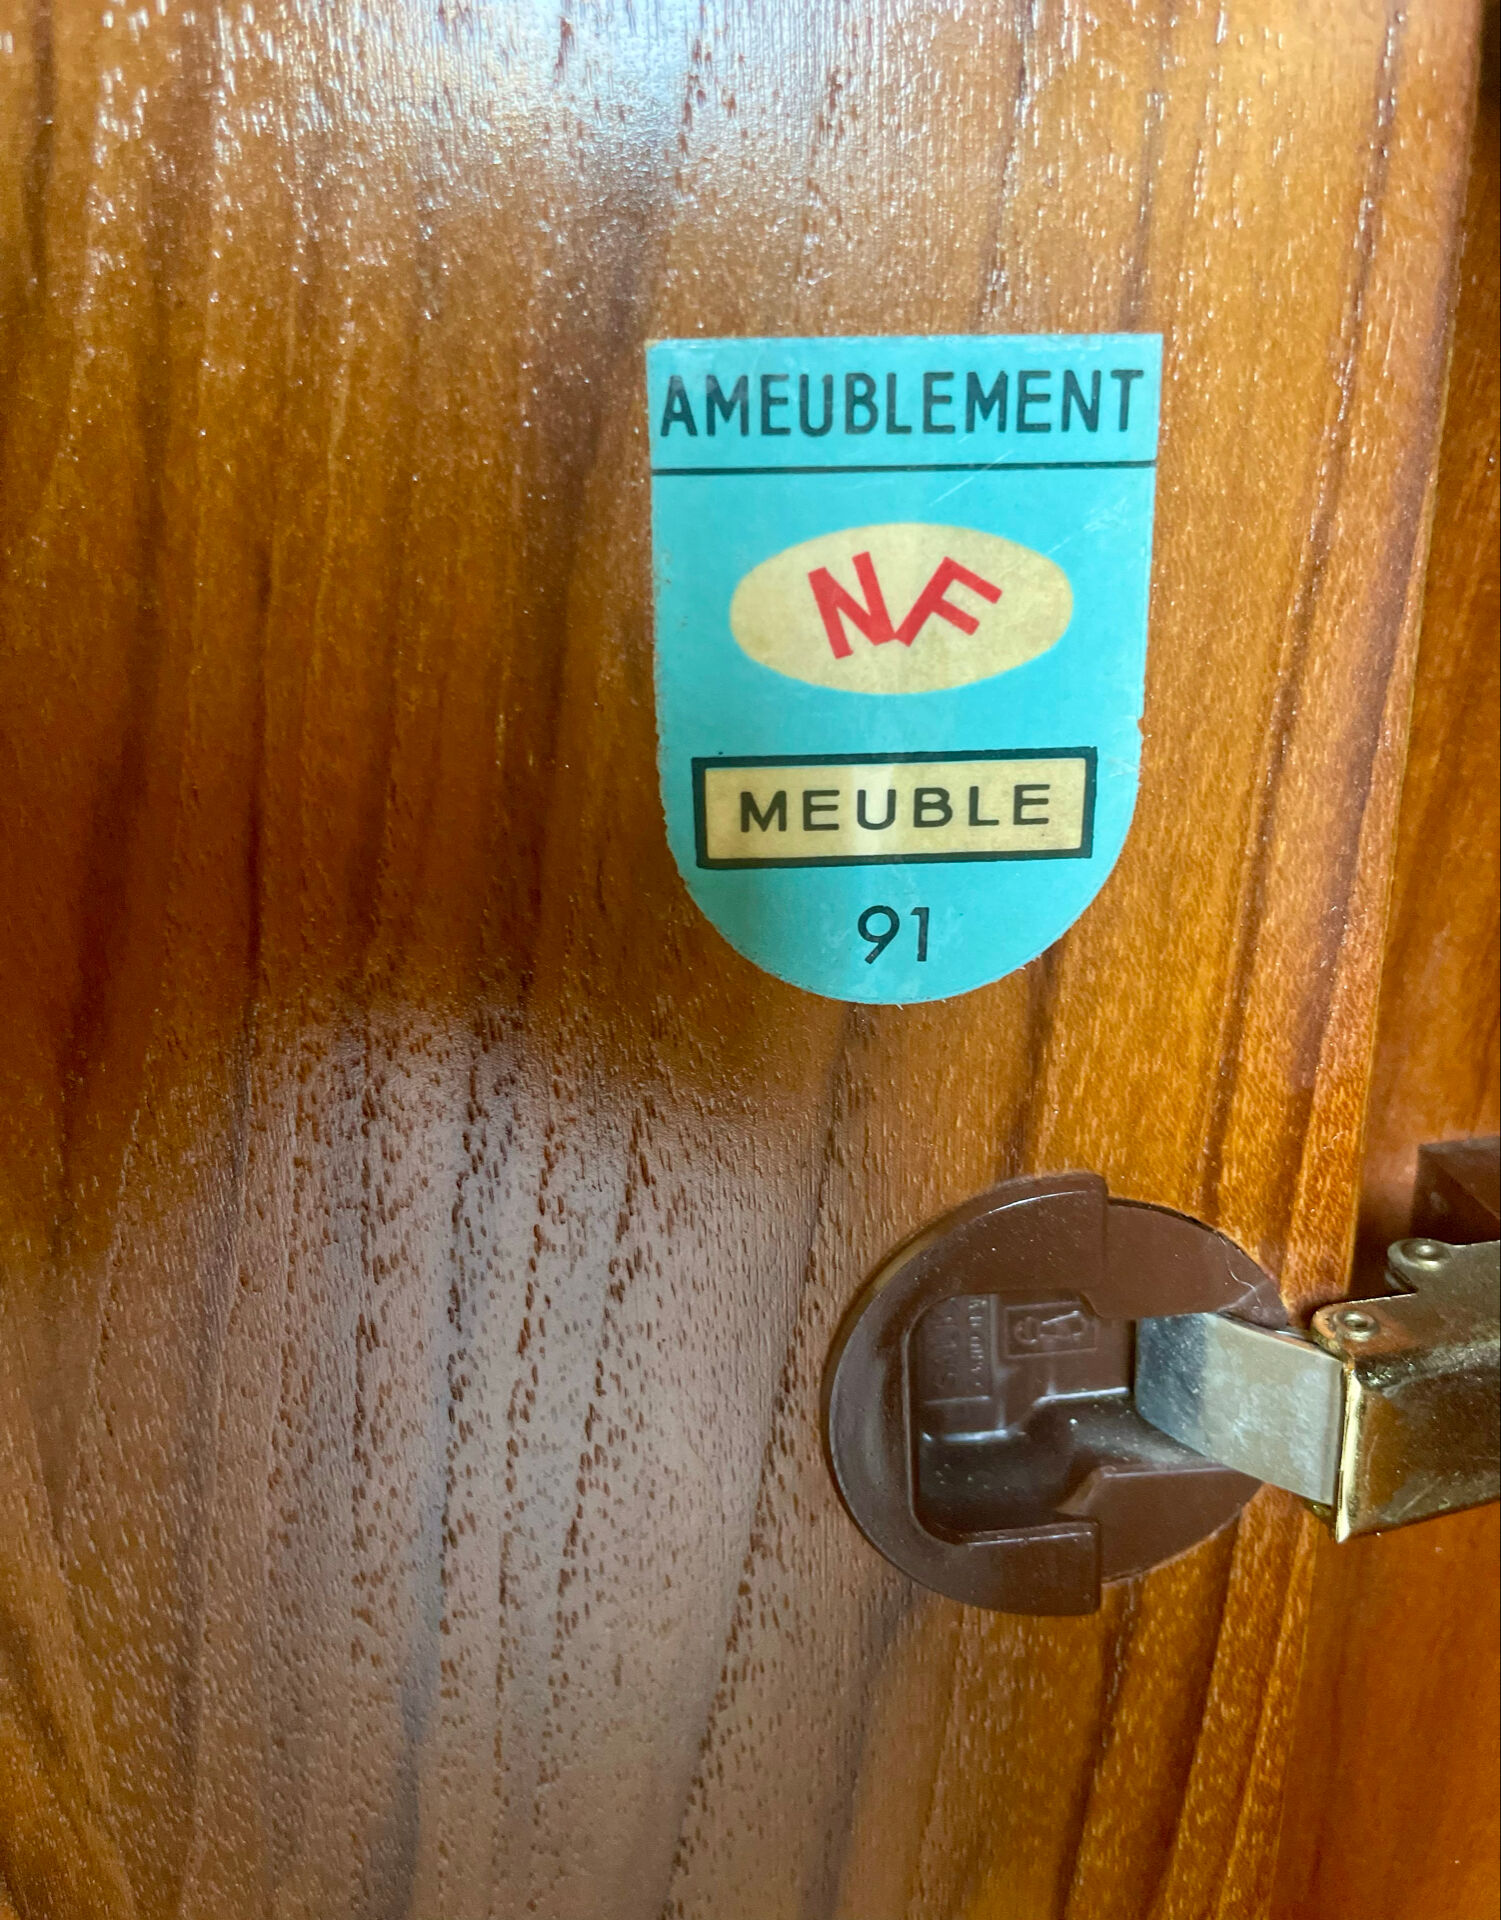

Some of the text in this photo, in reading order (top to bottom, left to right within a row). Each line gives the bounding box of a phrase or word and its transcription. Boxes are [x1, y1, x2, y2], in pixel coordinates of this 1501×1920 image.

[660, 368, 1144, 438] AMEUBLEMENT
[808, 551, 1002, 659] NF
[739, 784, 1051, 834] MEUBLE
[857, 904, 930, 965] 91
